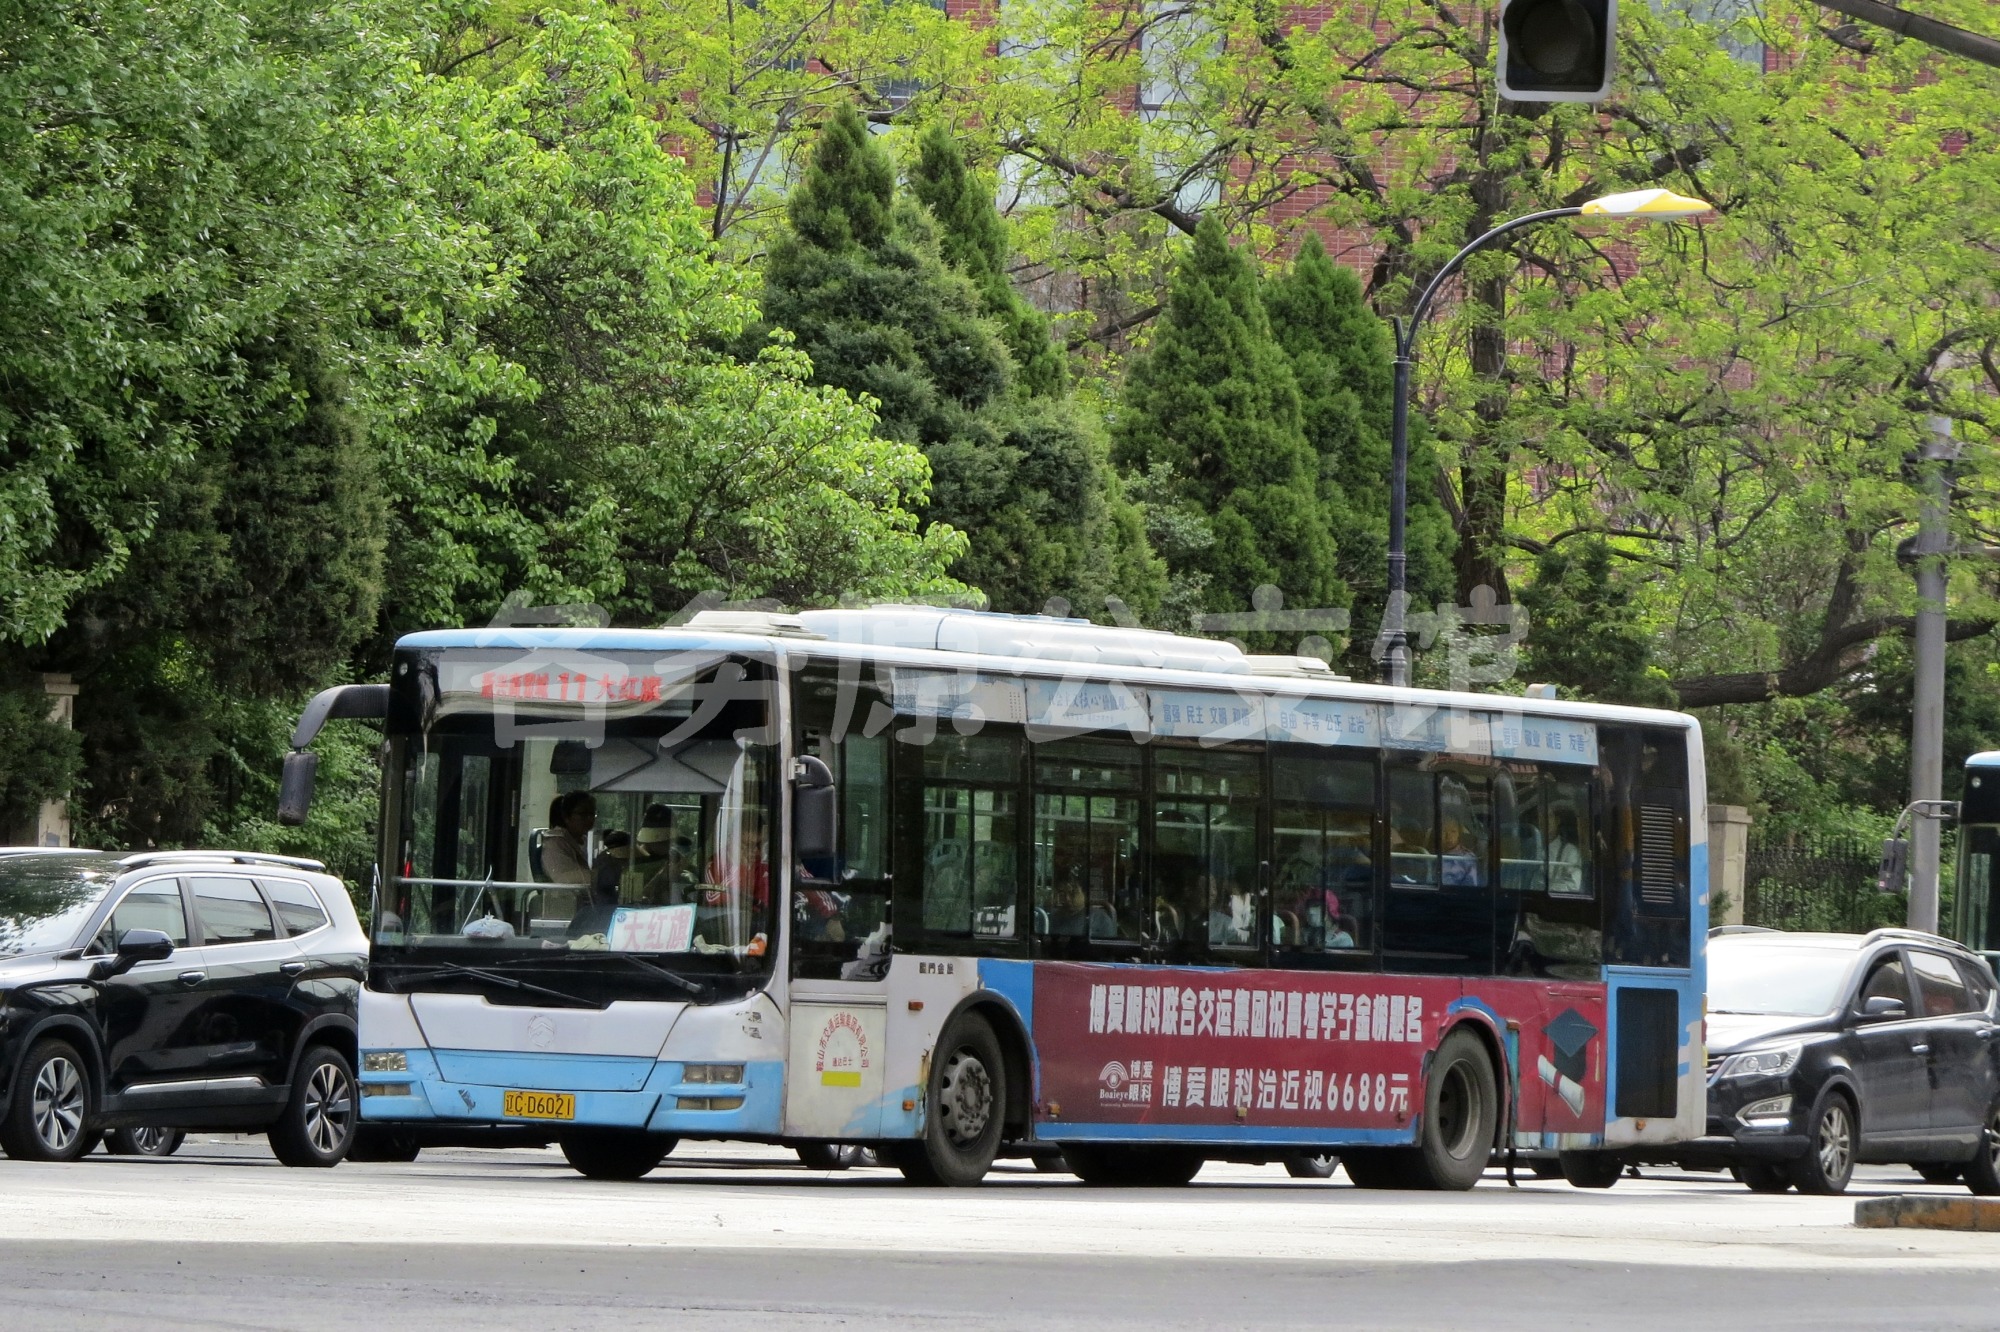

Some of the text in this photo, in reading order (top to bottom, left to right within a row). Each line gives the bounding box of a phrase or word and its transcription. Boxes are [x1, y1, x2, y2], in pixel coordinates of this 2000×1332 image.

[556, 672, 588, 700] 11
[594, 673, 665, 701] 大红旗
[1163, 704, 1250, 726] 富强 民主 文明 和谐
[1280, 711, 1365, 734] 自由 平等 公正 法治
[1503, 728, 1519, 747] 爱国
[1546, 732, 1562, 750] 诚信
[1568, 734, 1585, 752] 友善
[622, 908, 692, 952] 大红旗
[1090, 984, 1422, 1042] 博爱眼科联合交运集团祝高考学子金榜题名
[1130, 1060, 1153, 1079] 博爱
[1129, 1084, 1152, 1102] 眼科
[1162, 1065, 1409, 1112] 博爱眼科治近视6688元
